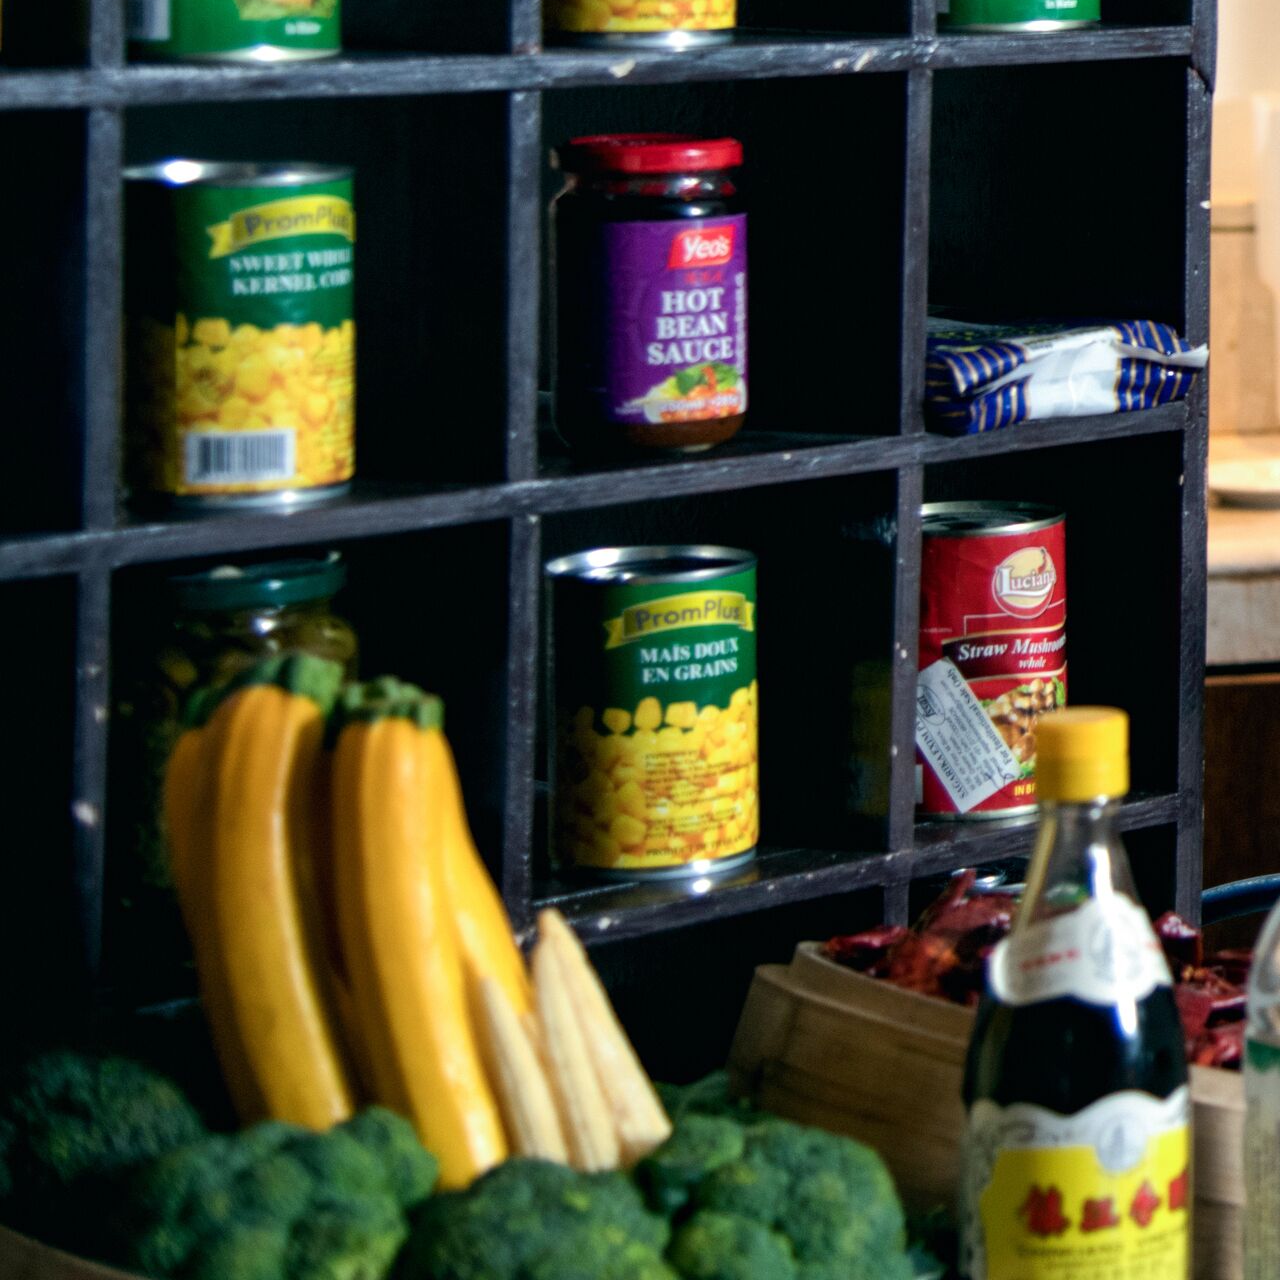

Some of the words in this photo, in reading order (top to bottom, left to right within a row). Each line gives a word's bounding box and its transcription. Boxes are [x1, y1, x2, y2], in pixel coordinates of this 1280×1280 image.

[662, 287, 725, 314] HOT
[656, 311, 728, 340] BEAN
[647, 336, 735, 366] SAUCE
[635, 598, 741, 630] PromPlus
[694, 637, 739, 659] DOUX
[958, 643, 1008, 661] Straw
[643, 667, 670, 684] EN
[674, 657, 738, 681] GRAINS
[1019, 656, 1047, 669] whole
[957, 686, 974, 705] Sale
[968, 703, 1003, 751] Institutional
[998, 749, 1013, 765] For
[1014, 784, 1026, 796] IN
